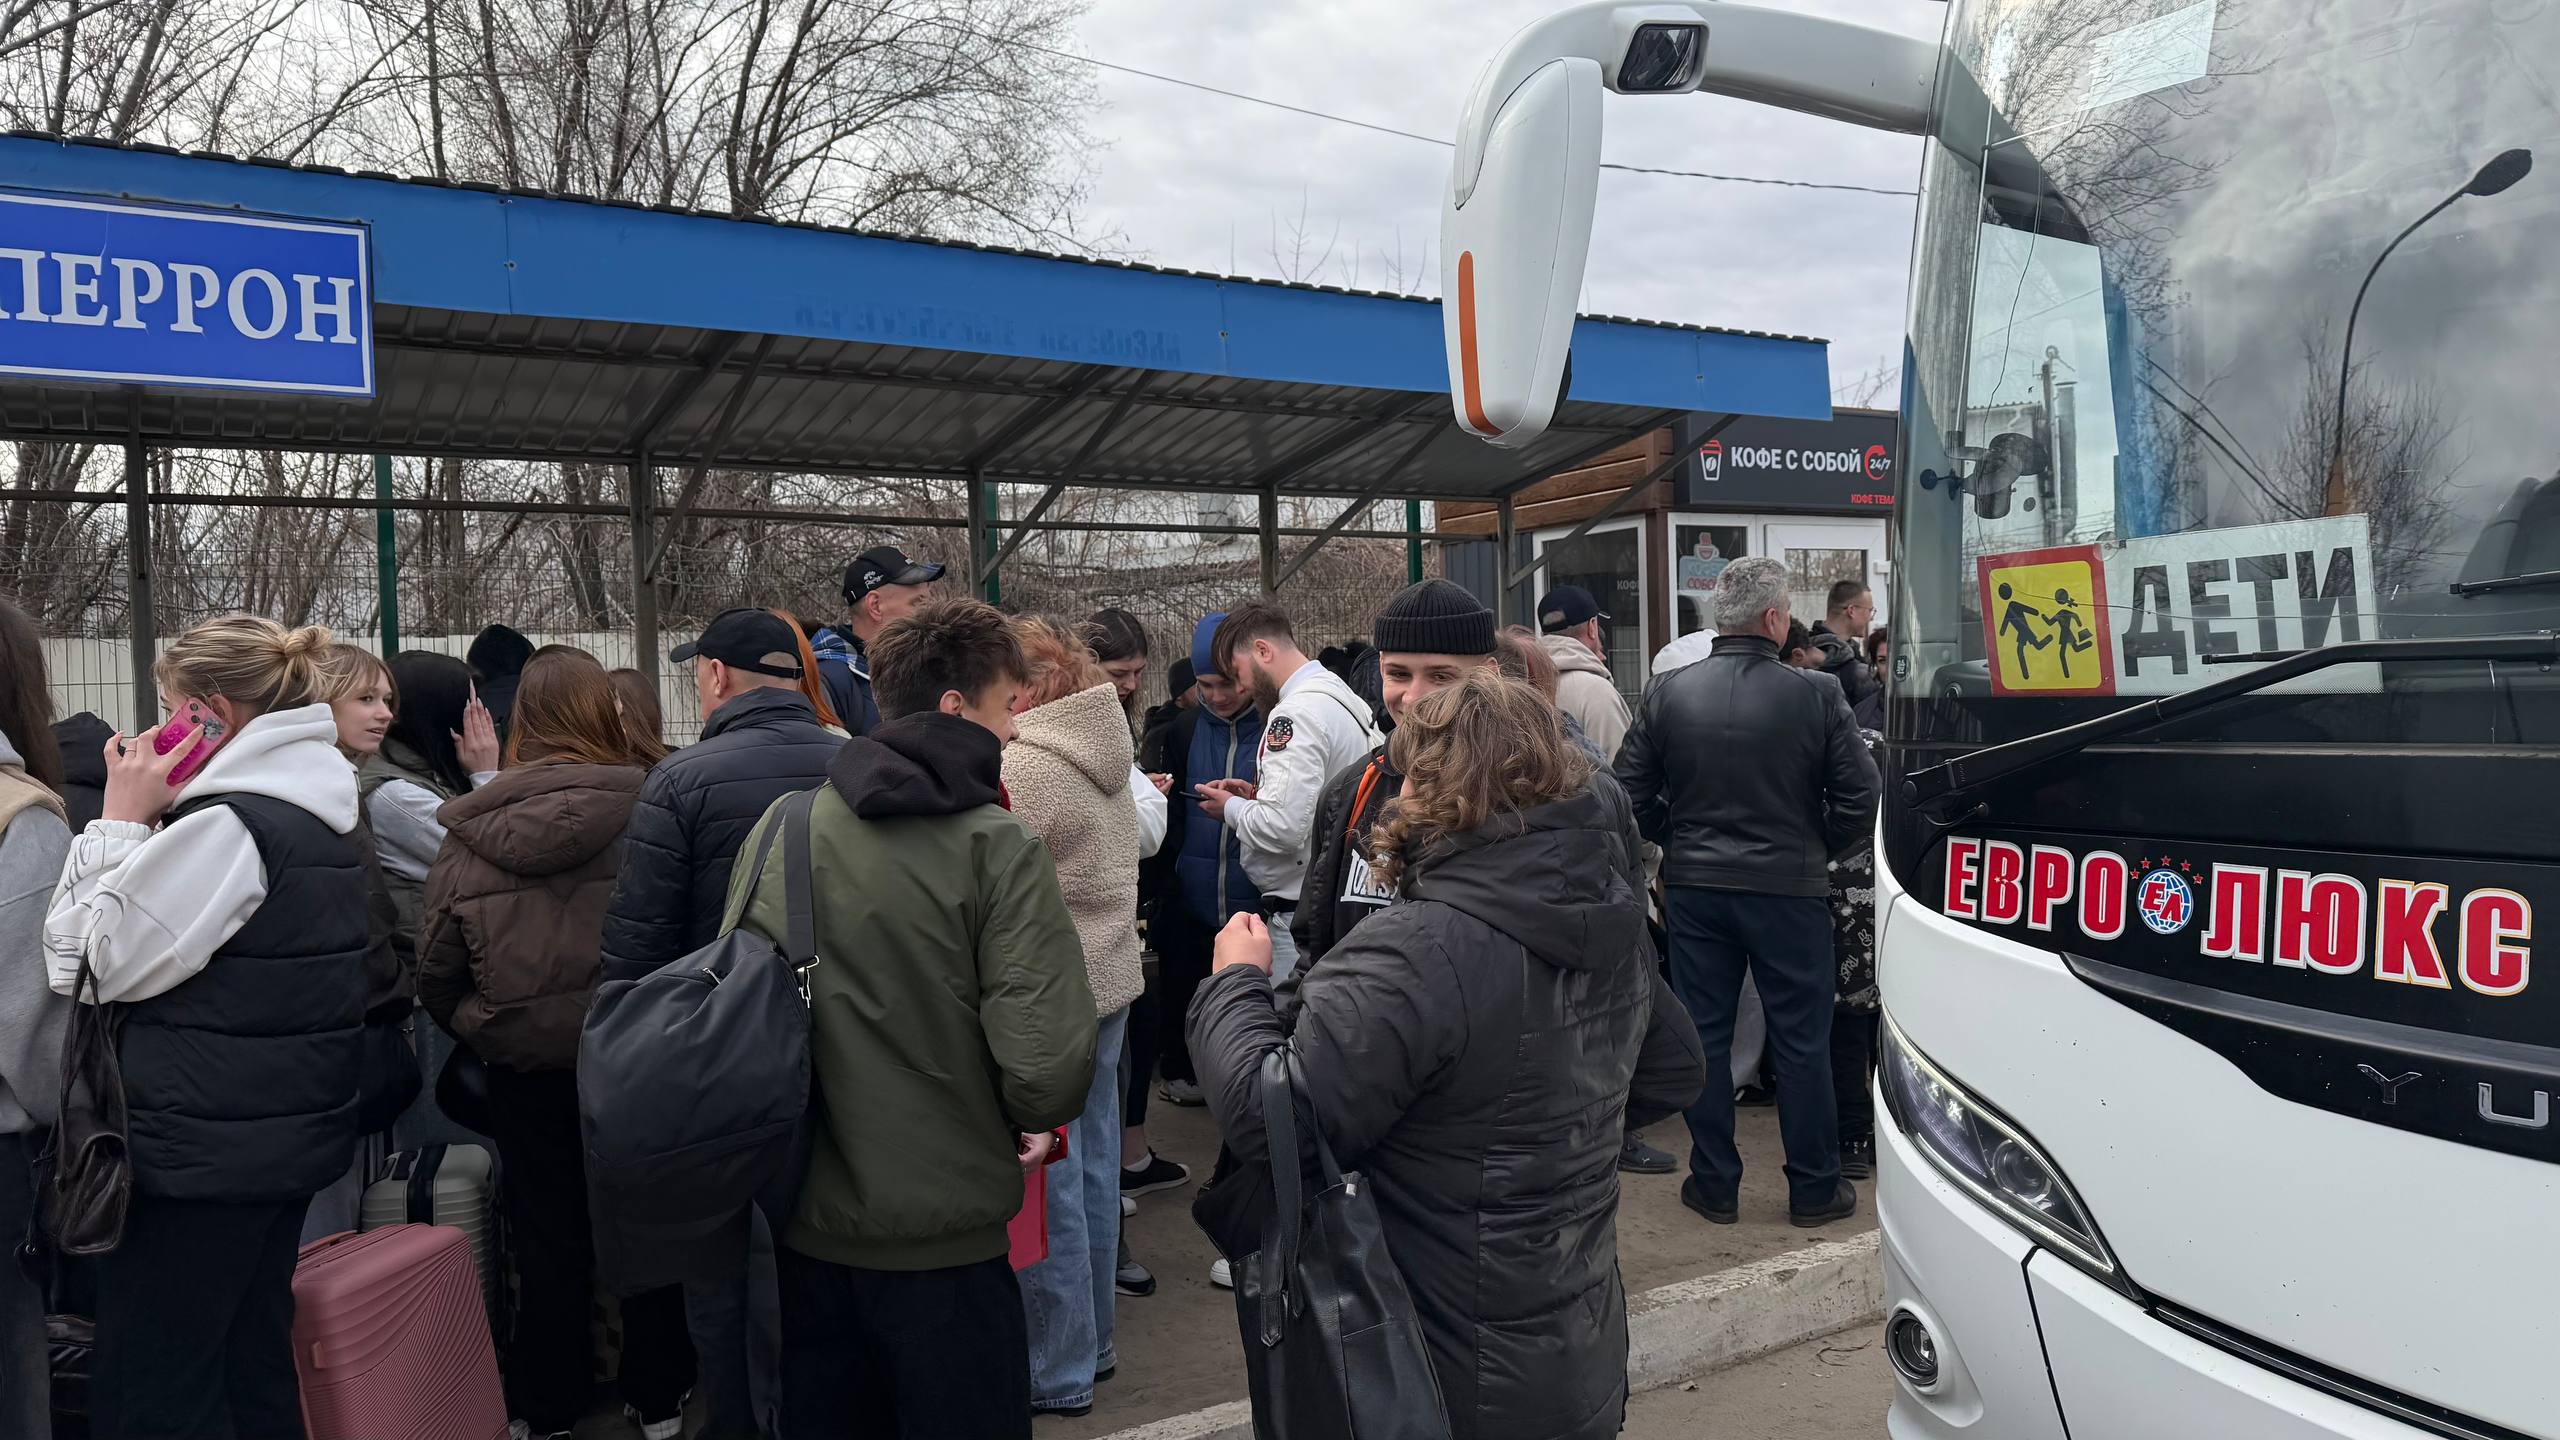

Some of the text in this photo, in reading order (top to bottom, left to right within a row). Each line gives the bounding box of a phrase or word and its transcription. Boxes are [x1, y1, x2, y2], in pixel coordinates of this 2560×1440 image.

[0, 247, 357, 344] ПЕРРОН
[1731, 446, 1891, 473] КОФЕ С СОБОЙ 24/7
[1851, 494, 1873, 504] КОФЕ
[2122, 547, 2361, 677] ДЕТИ
[1944, 836, 2532, 997] ЕВРО ЛЮКС
